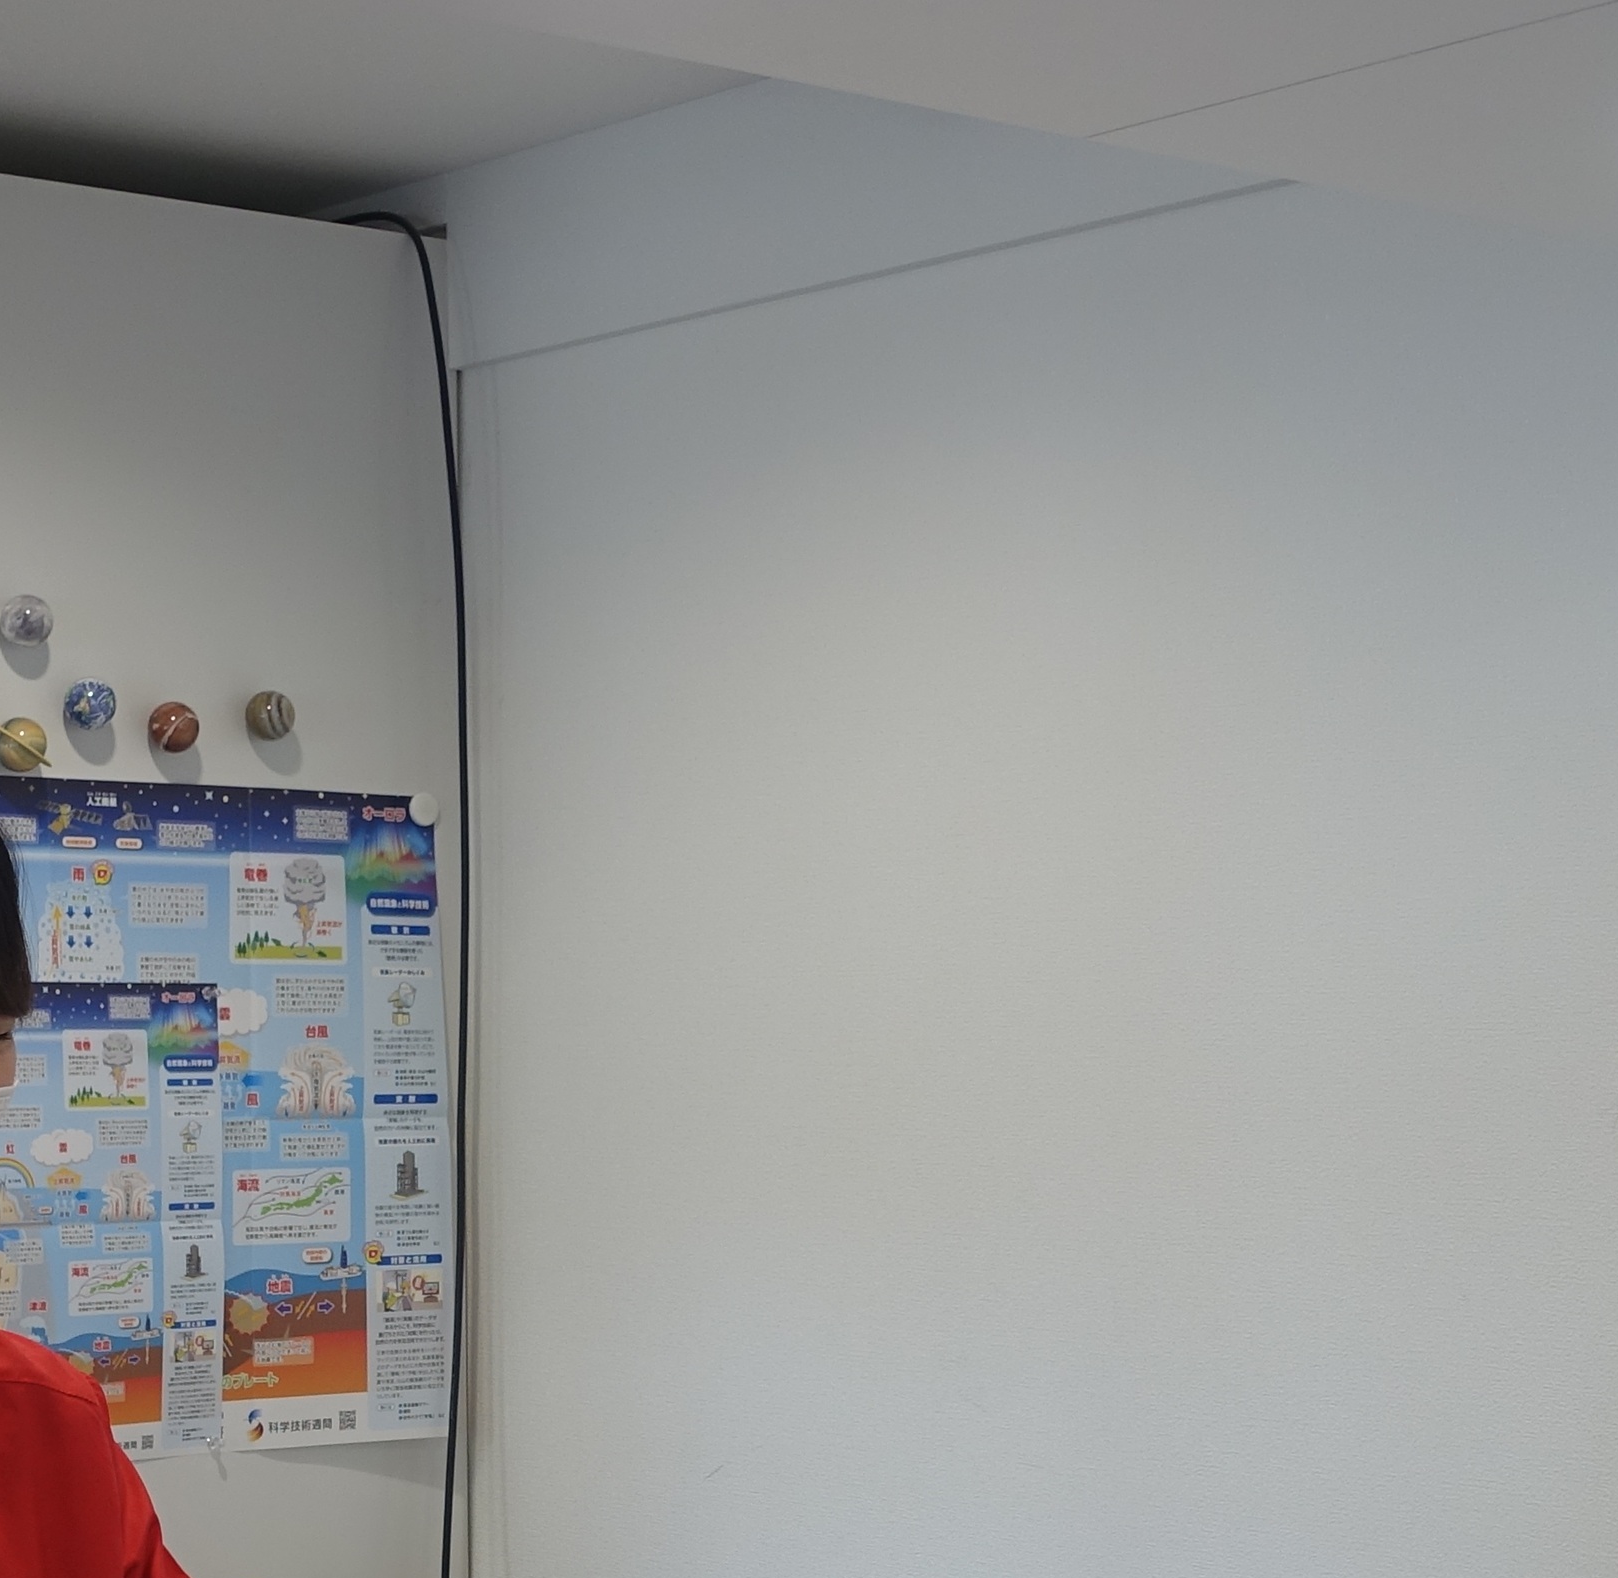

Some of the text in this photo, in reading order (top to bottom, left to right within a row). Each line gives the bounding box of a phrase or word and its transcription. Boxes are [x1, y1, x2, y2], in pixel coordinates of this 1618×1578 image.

[362, 806, 407, 821] オーロラ
[305, 1024, 329, 1039] 台風
[236, 1178, 260, 1193] 海流
[266, 1278, 293, 1294] 地震
[268, 1417, 333, 1434] 科学技術週間
